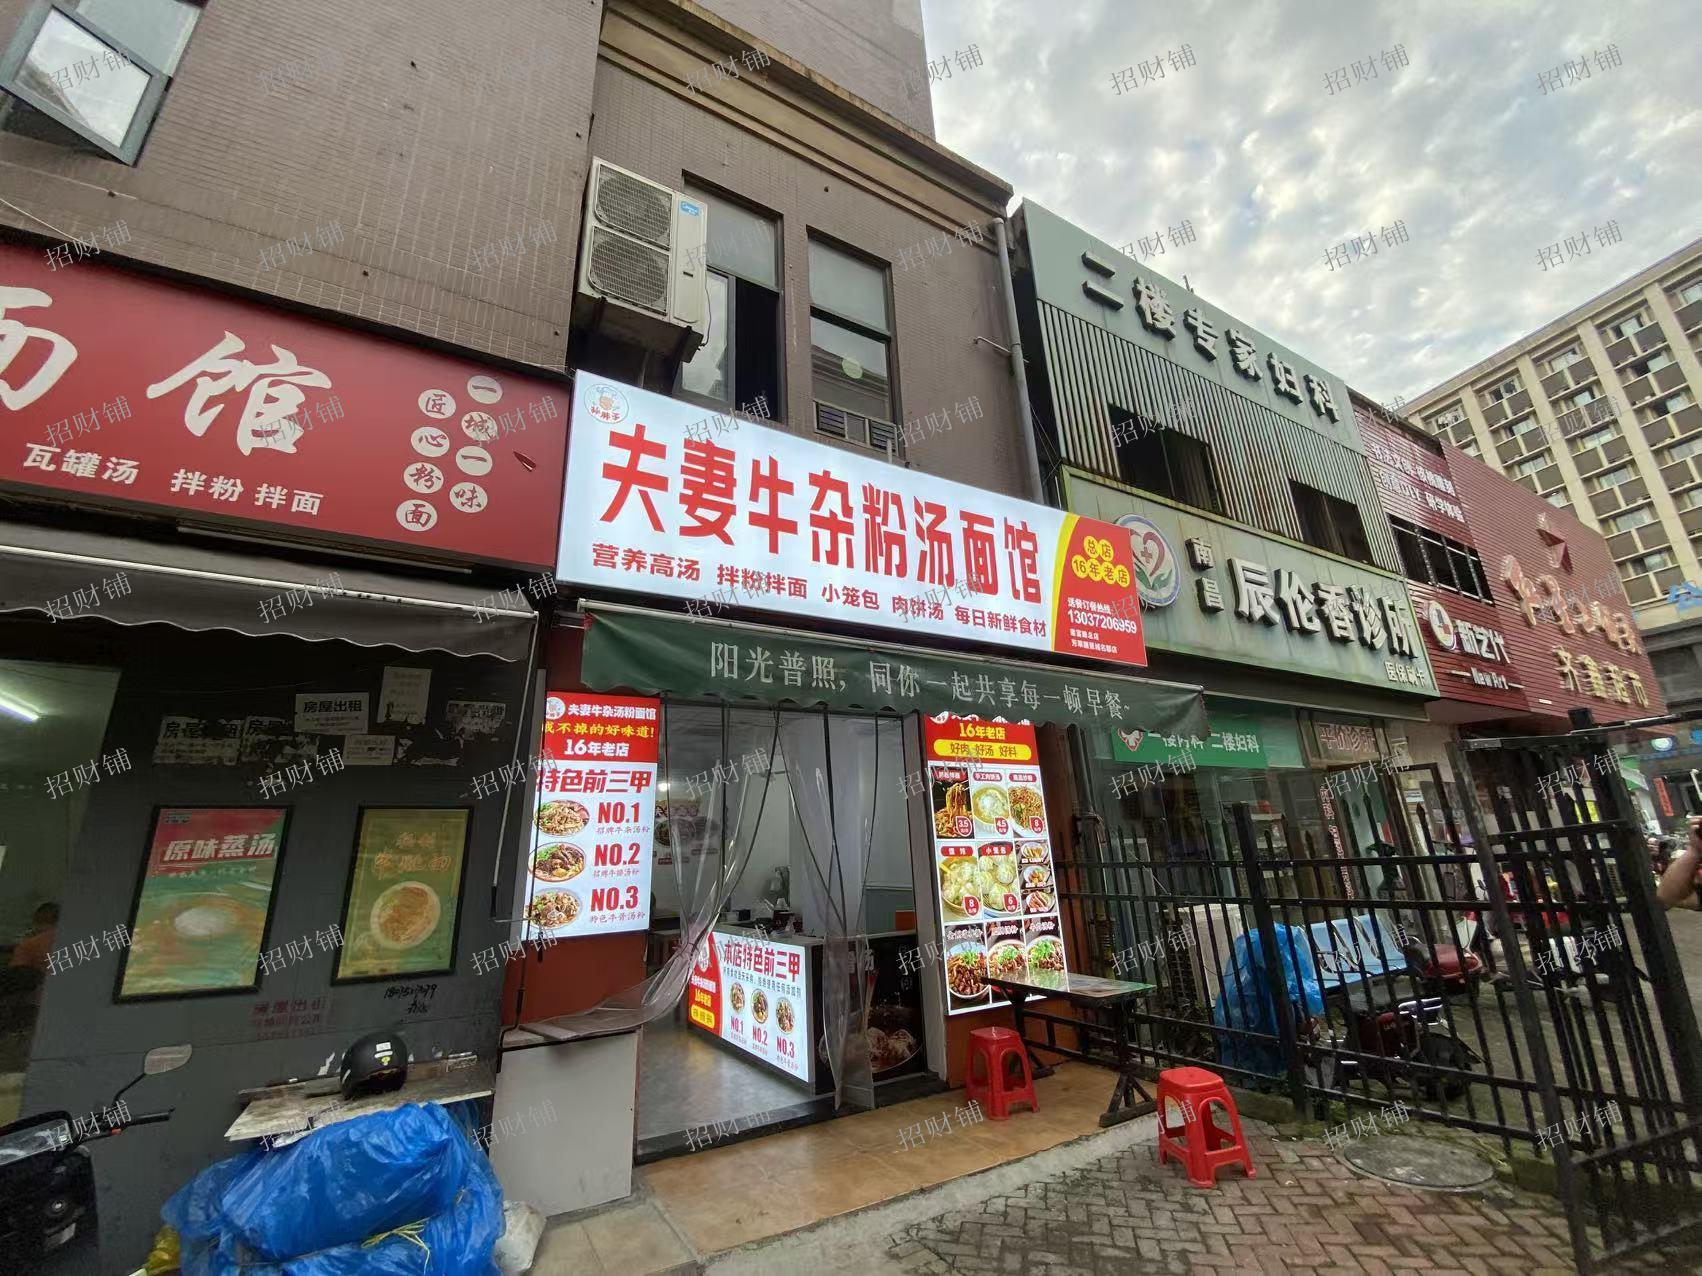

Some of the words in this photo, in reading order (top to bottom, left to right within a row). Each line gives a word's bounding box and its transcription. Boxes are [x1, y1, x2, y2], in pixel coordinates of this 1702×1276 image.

[1081, 250, 1341, 425] 二楼专家妇科
[403, 393, 447, 527] 匠心粉面
[23, 443, 140, 485] 瓦罐汤
[171, 468, 243, 503] 拌粉
[255, 483, 324, 516] 拌面
[600, 423, 1042, 605] 夫妻牛杂粉汤面馆
[1073, 558, 1129, 585] 16年老店
[1184, 536, 1225, 612] 南昌
[592, 543, 701, 582] 营养高汤
[717, 564, 808, 600] 拌粉拌面
[821, 583, 880, 612] 小笼包
[891, 595, 944, 621] 肉饼汤
[955, 604, 1047, 638] 每日新鲜食材
[1067, 608, 1137, 634] 13037206959
[1227, 557, 1418, 660] 辰伦香诊所
[303, 700, 362, 713] 房屋出租
[568, 703, 657, 720] 夫妻牛杂汤粉面馆
[959, 722, 1006, 740] 16年老店
[1211, 731, 1260, 754] 二楼妇科
[564, 738, 630, 757] 16年老店
[950, 742, 970, 755] 好肉
[975, 744, 994, 757] 好汤
[999, 745, 1017, 758] 好料
[536, 768, 652, 795] 特色前三甲
[597, 801, 640, 824] NO.1
[163, 832, 277, 861] 原味蒸汤
[593, 842, 641, 867] NO.2
[590, 885, 639, 912] NO.3
[723, 941, 801, 983] 本店特色前三甲
[730, 1015, 745, 1035] NO.1
[752, 1025, 769, 1046] NO.2
[776, 1036, 796, 1059] NO.3
